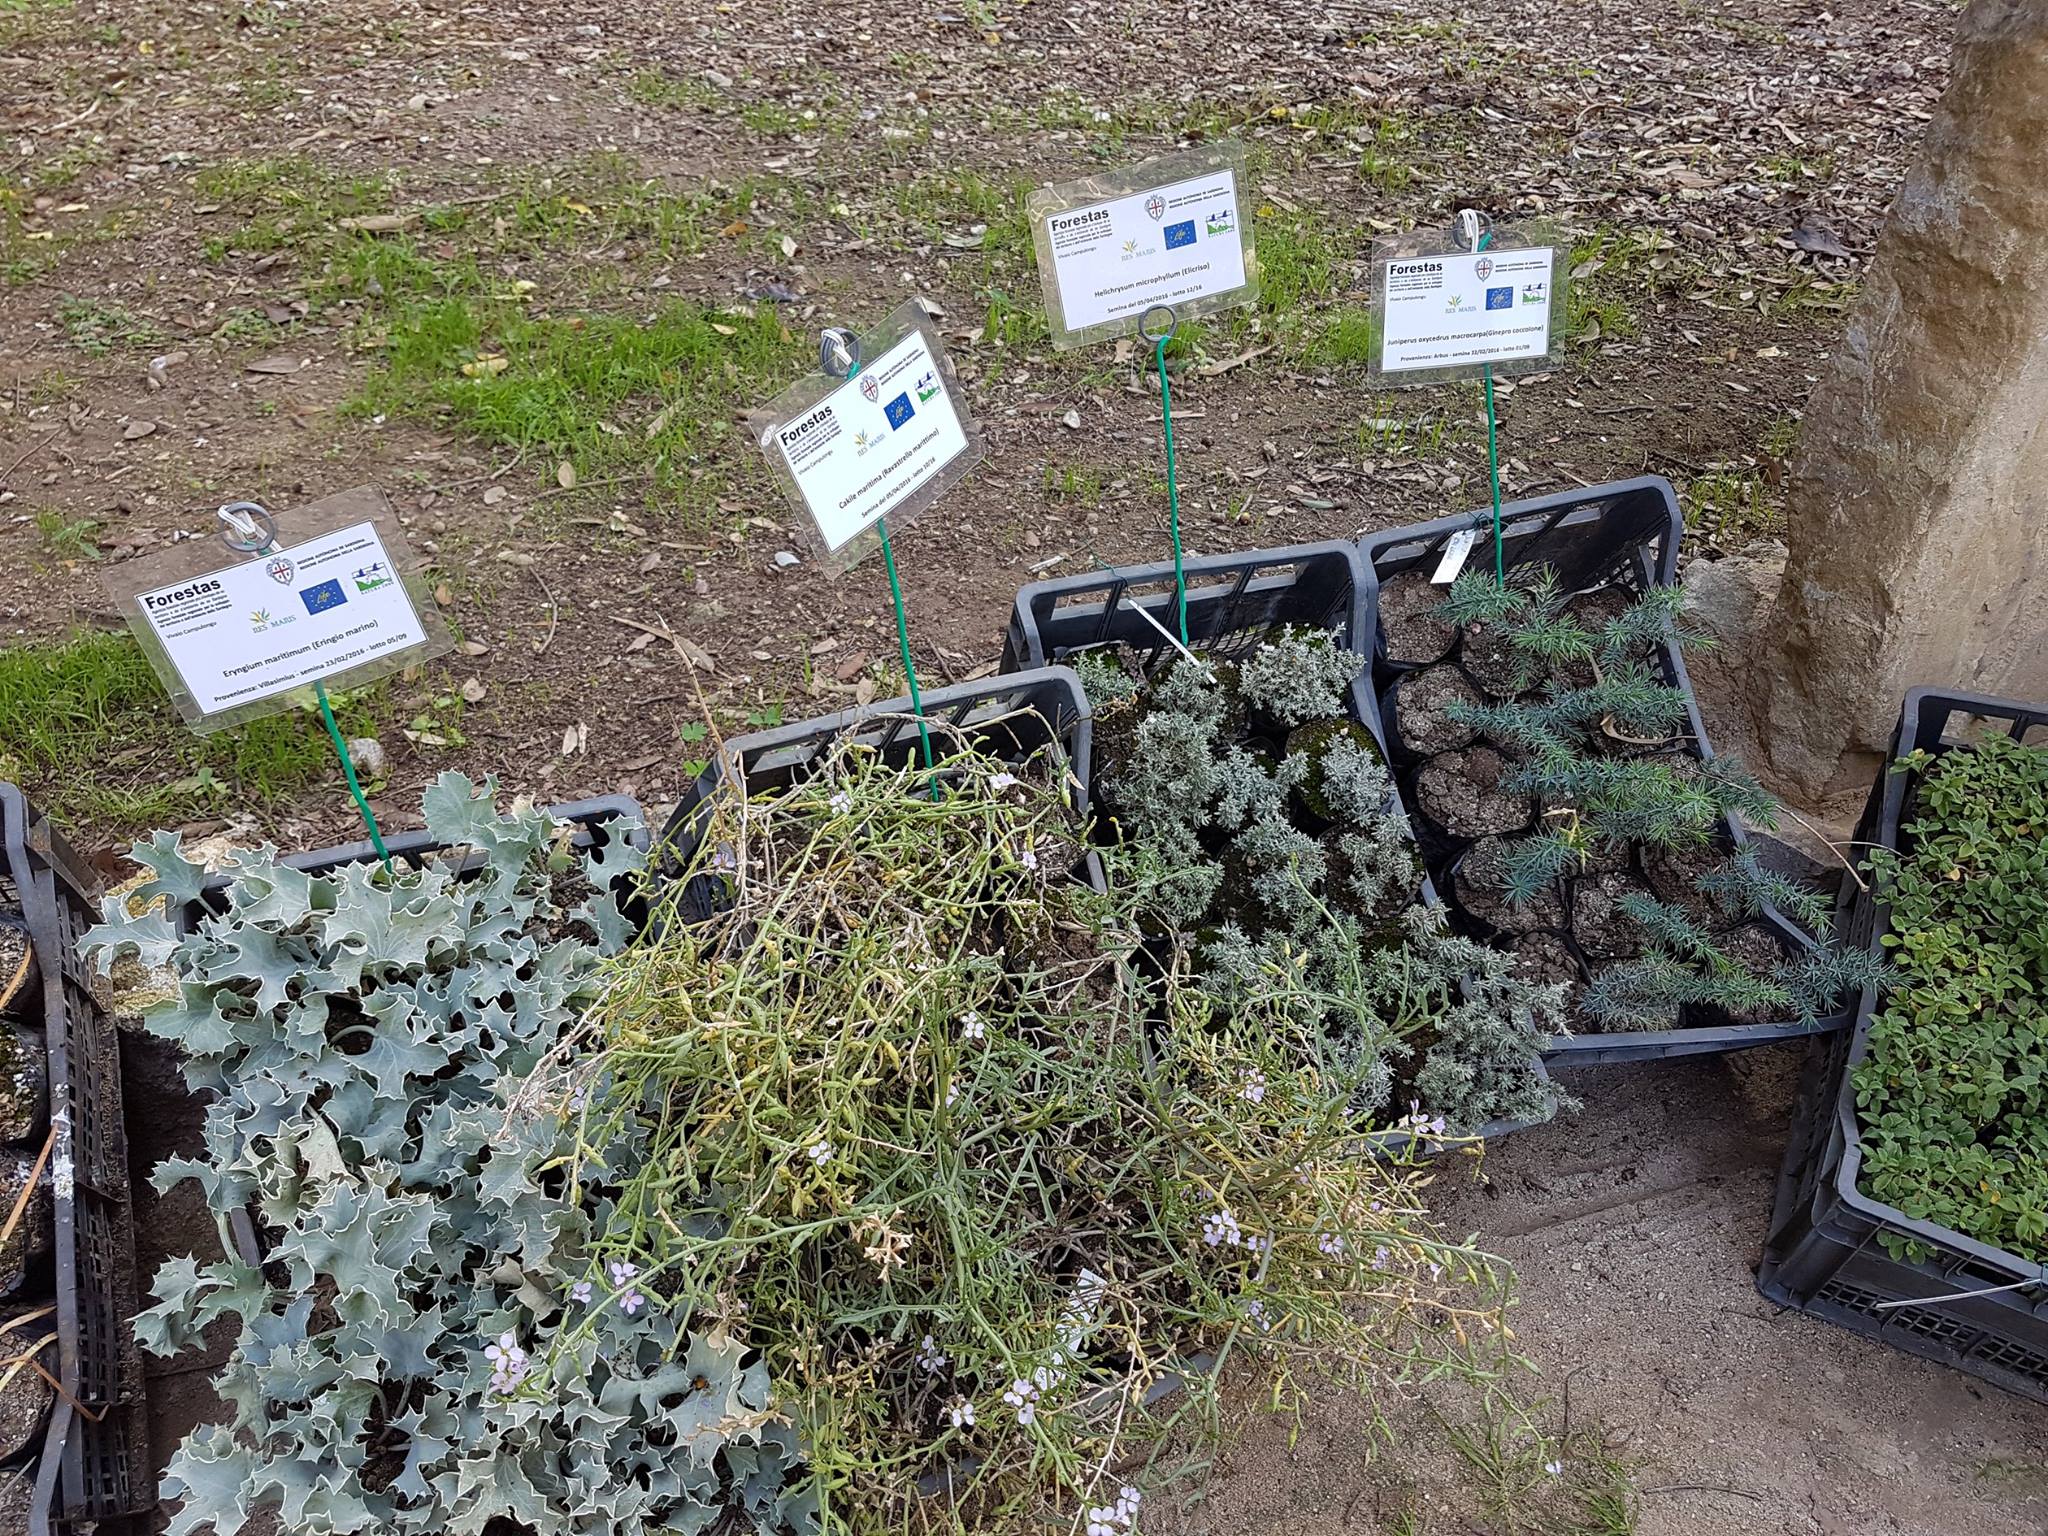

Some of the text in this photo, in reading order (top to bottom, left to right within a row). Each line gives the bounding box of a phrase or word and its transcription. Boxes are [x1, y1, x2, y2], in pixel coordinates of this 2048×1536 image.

[1051, 210, 1109, 232] Forestas
[1390, 262, 1443, 275] Forestas
[1094, 262, 1210, 298] Helichrysum microphyllum (Elicriso)
[1107, 305, 1127, 314] Semina
[1387, 338, 1417, 346] Juniperus
[1418, 335, 1449, 343] oxycedrus
[780, 406, 832, 446] Forestas
[839, 427, 939, 509] Cakile maritima (Ravastrello marittimo)
[861, 503, 879, 518] Semina
[144, 580, 221, 609] Forestas
[166, 631, 183, 639] Vivaio
[252, 615, 296, 634] RES MARIS
[222, 619, 378, 677] Eryngium maritimum (Eringio marino)
[214, 686, 258, 702] Provenienza:
[257, 674, 296, 688] Villasimius
[300, 664, 325, 675] semina
[325, 648, 365, 667] 23/02/2016
[369, 641, 386, 650] lotto
[386, 633, 407, 644] 05/09
